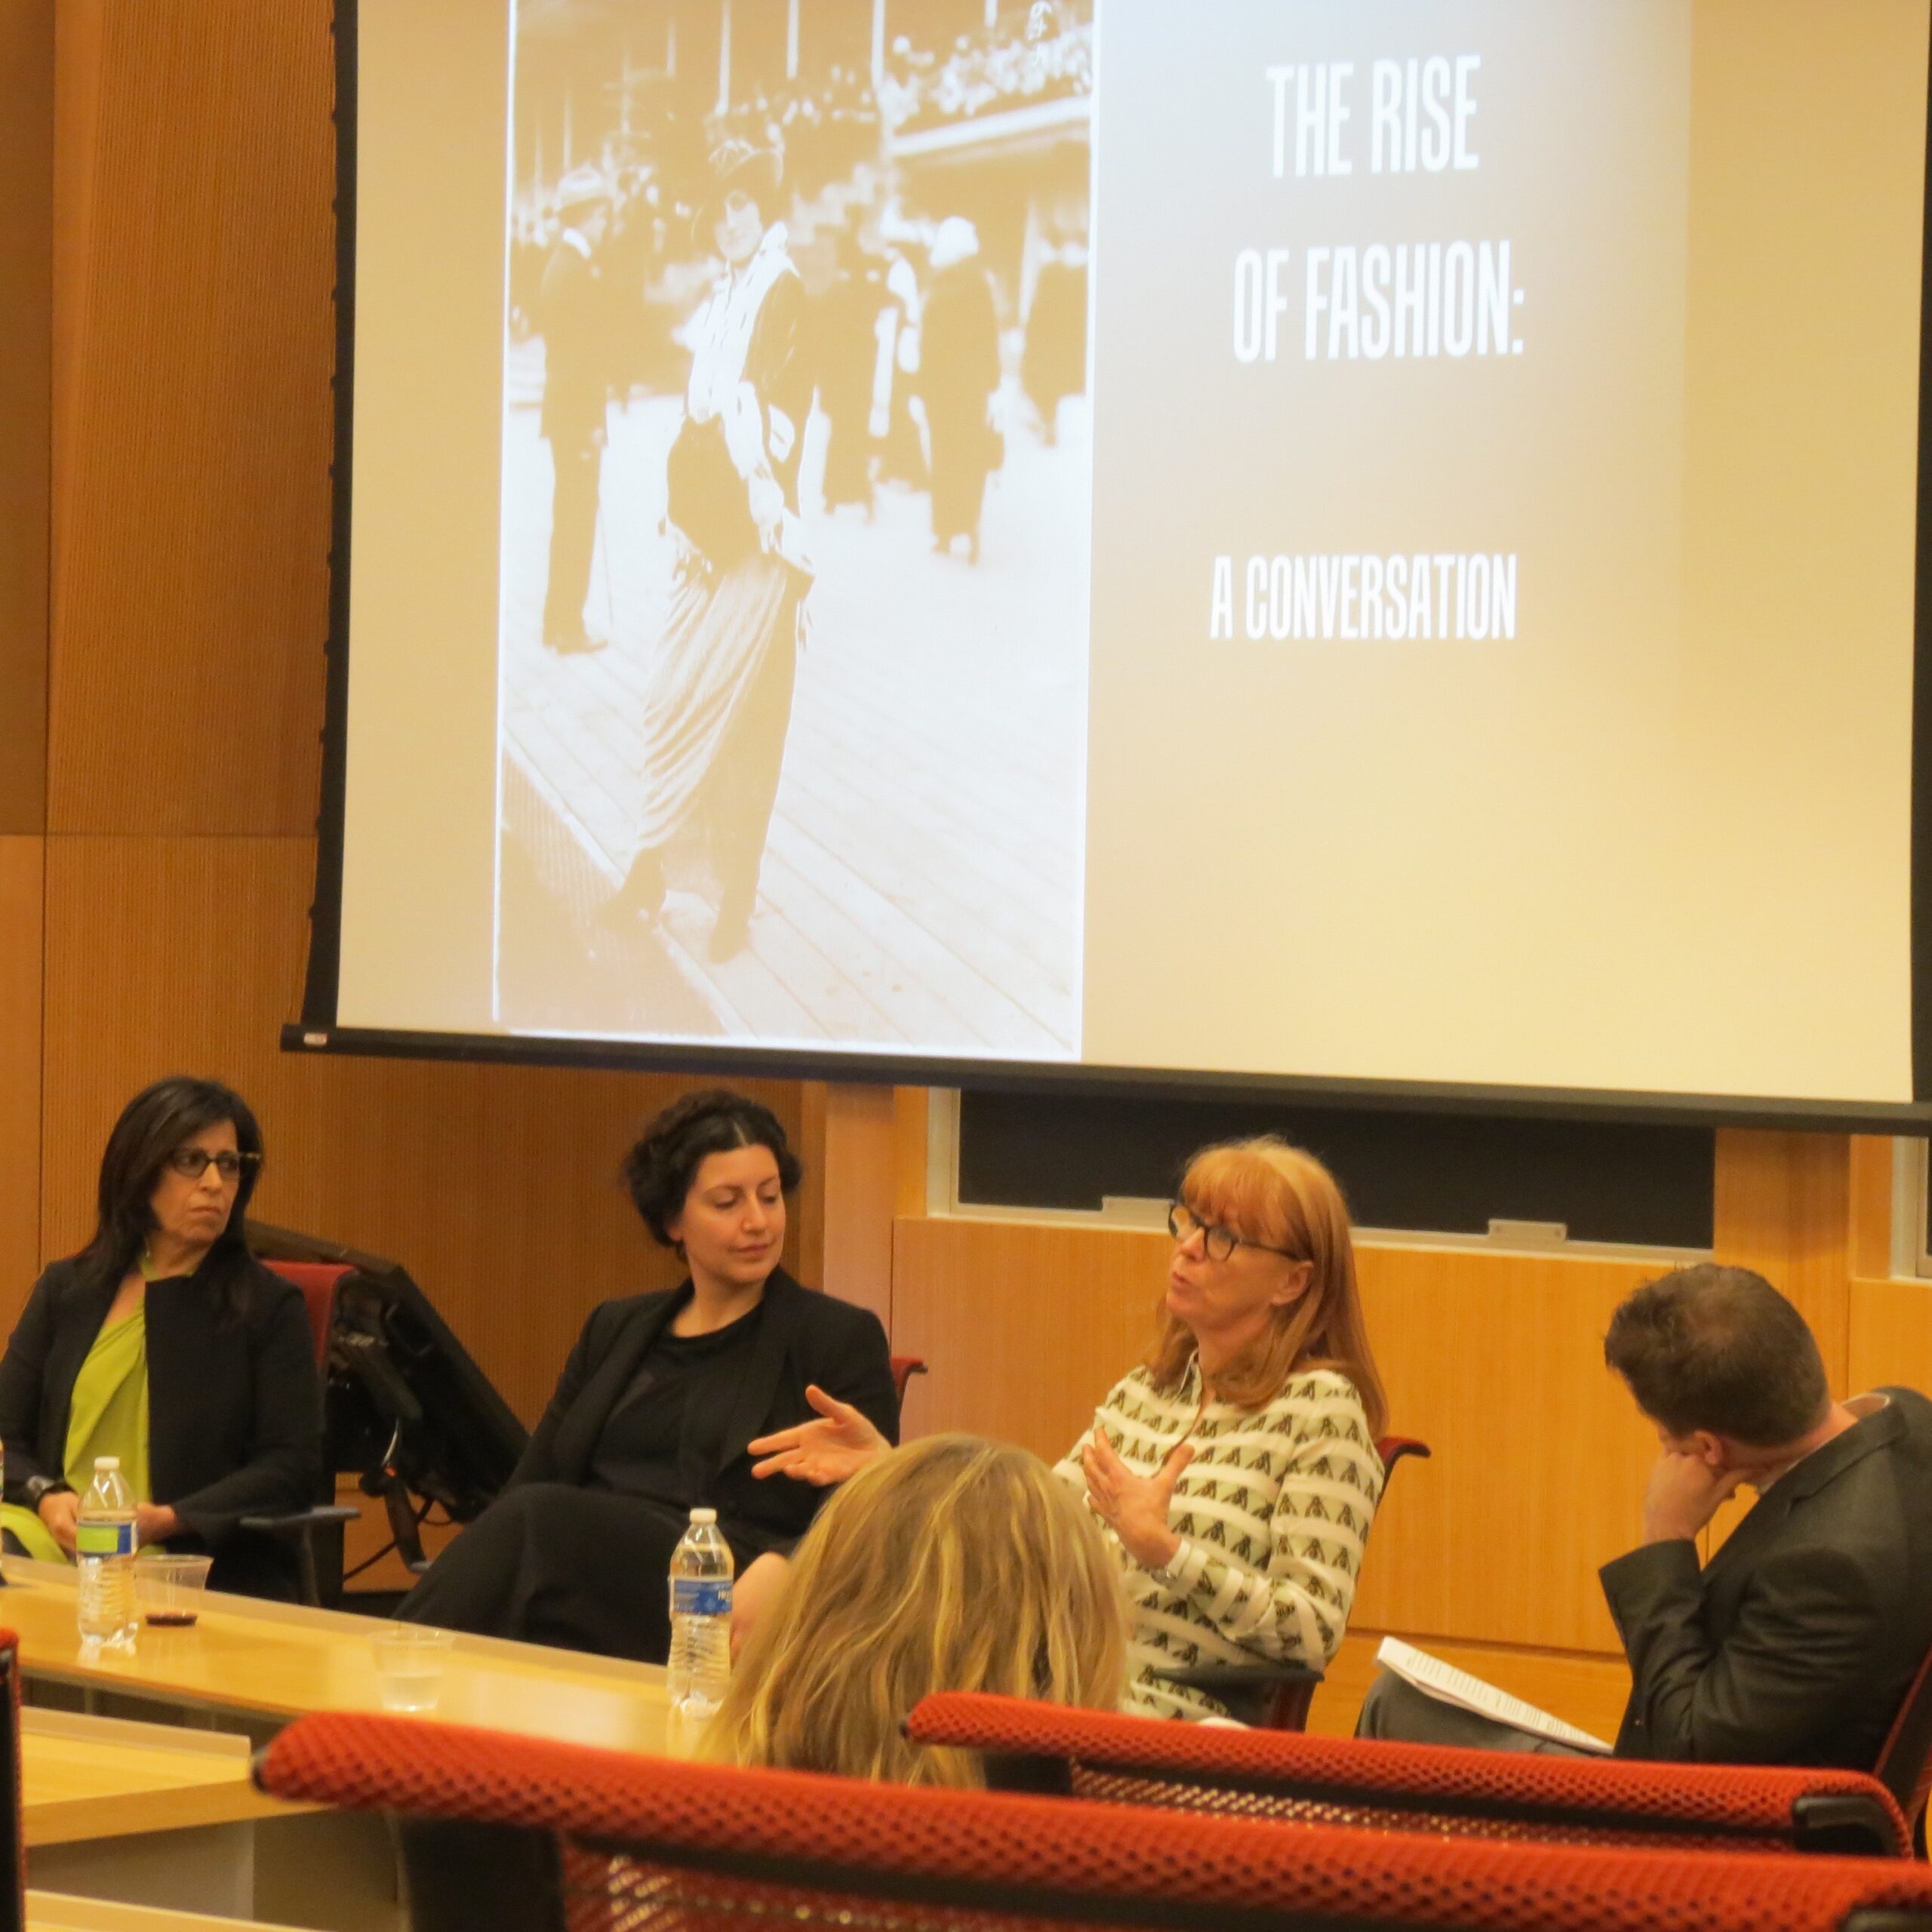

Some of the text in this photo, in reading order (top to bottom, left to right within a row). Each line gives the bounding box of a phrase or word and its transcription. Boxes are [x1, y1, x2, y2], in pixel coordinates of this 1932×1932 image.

[1265, 54, 1481, 178] THE RISE
[1233, 239, 1525, 364] OF FASHION:
[1209, 553, 1517, 641] A CONVERSATION
